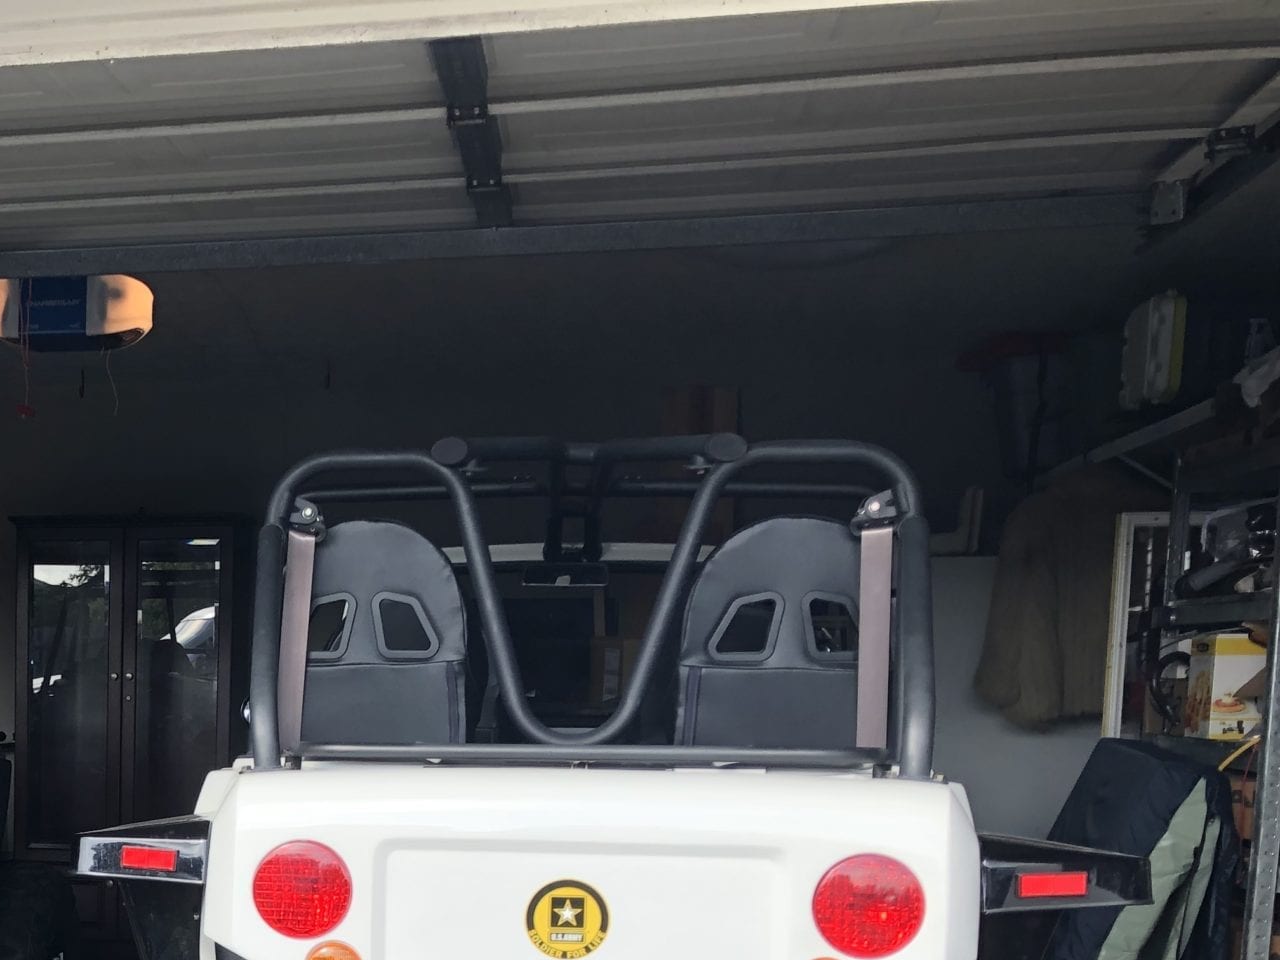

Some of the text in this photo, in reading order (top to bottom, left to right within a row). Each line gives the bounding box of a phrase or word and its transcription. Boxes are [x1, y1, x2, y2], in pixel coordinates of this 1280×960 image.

[528, 929, 606, 959] SOLDIER FOR LIFE
